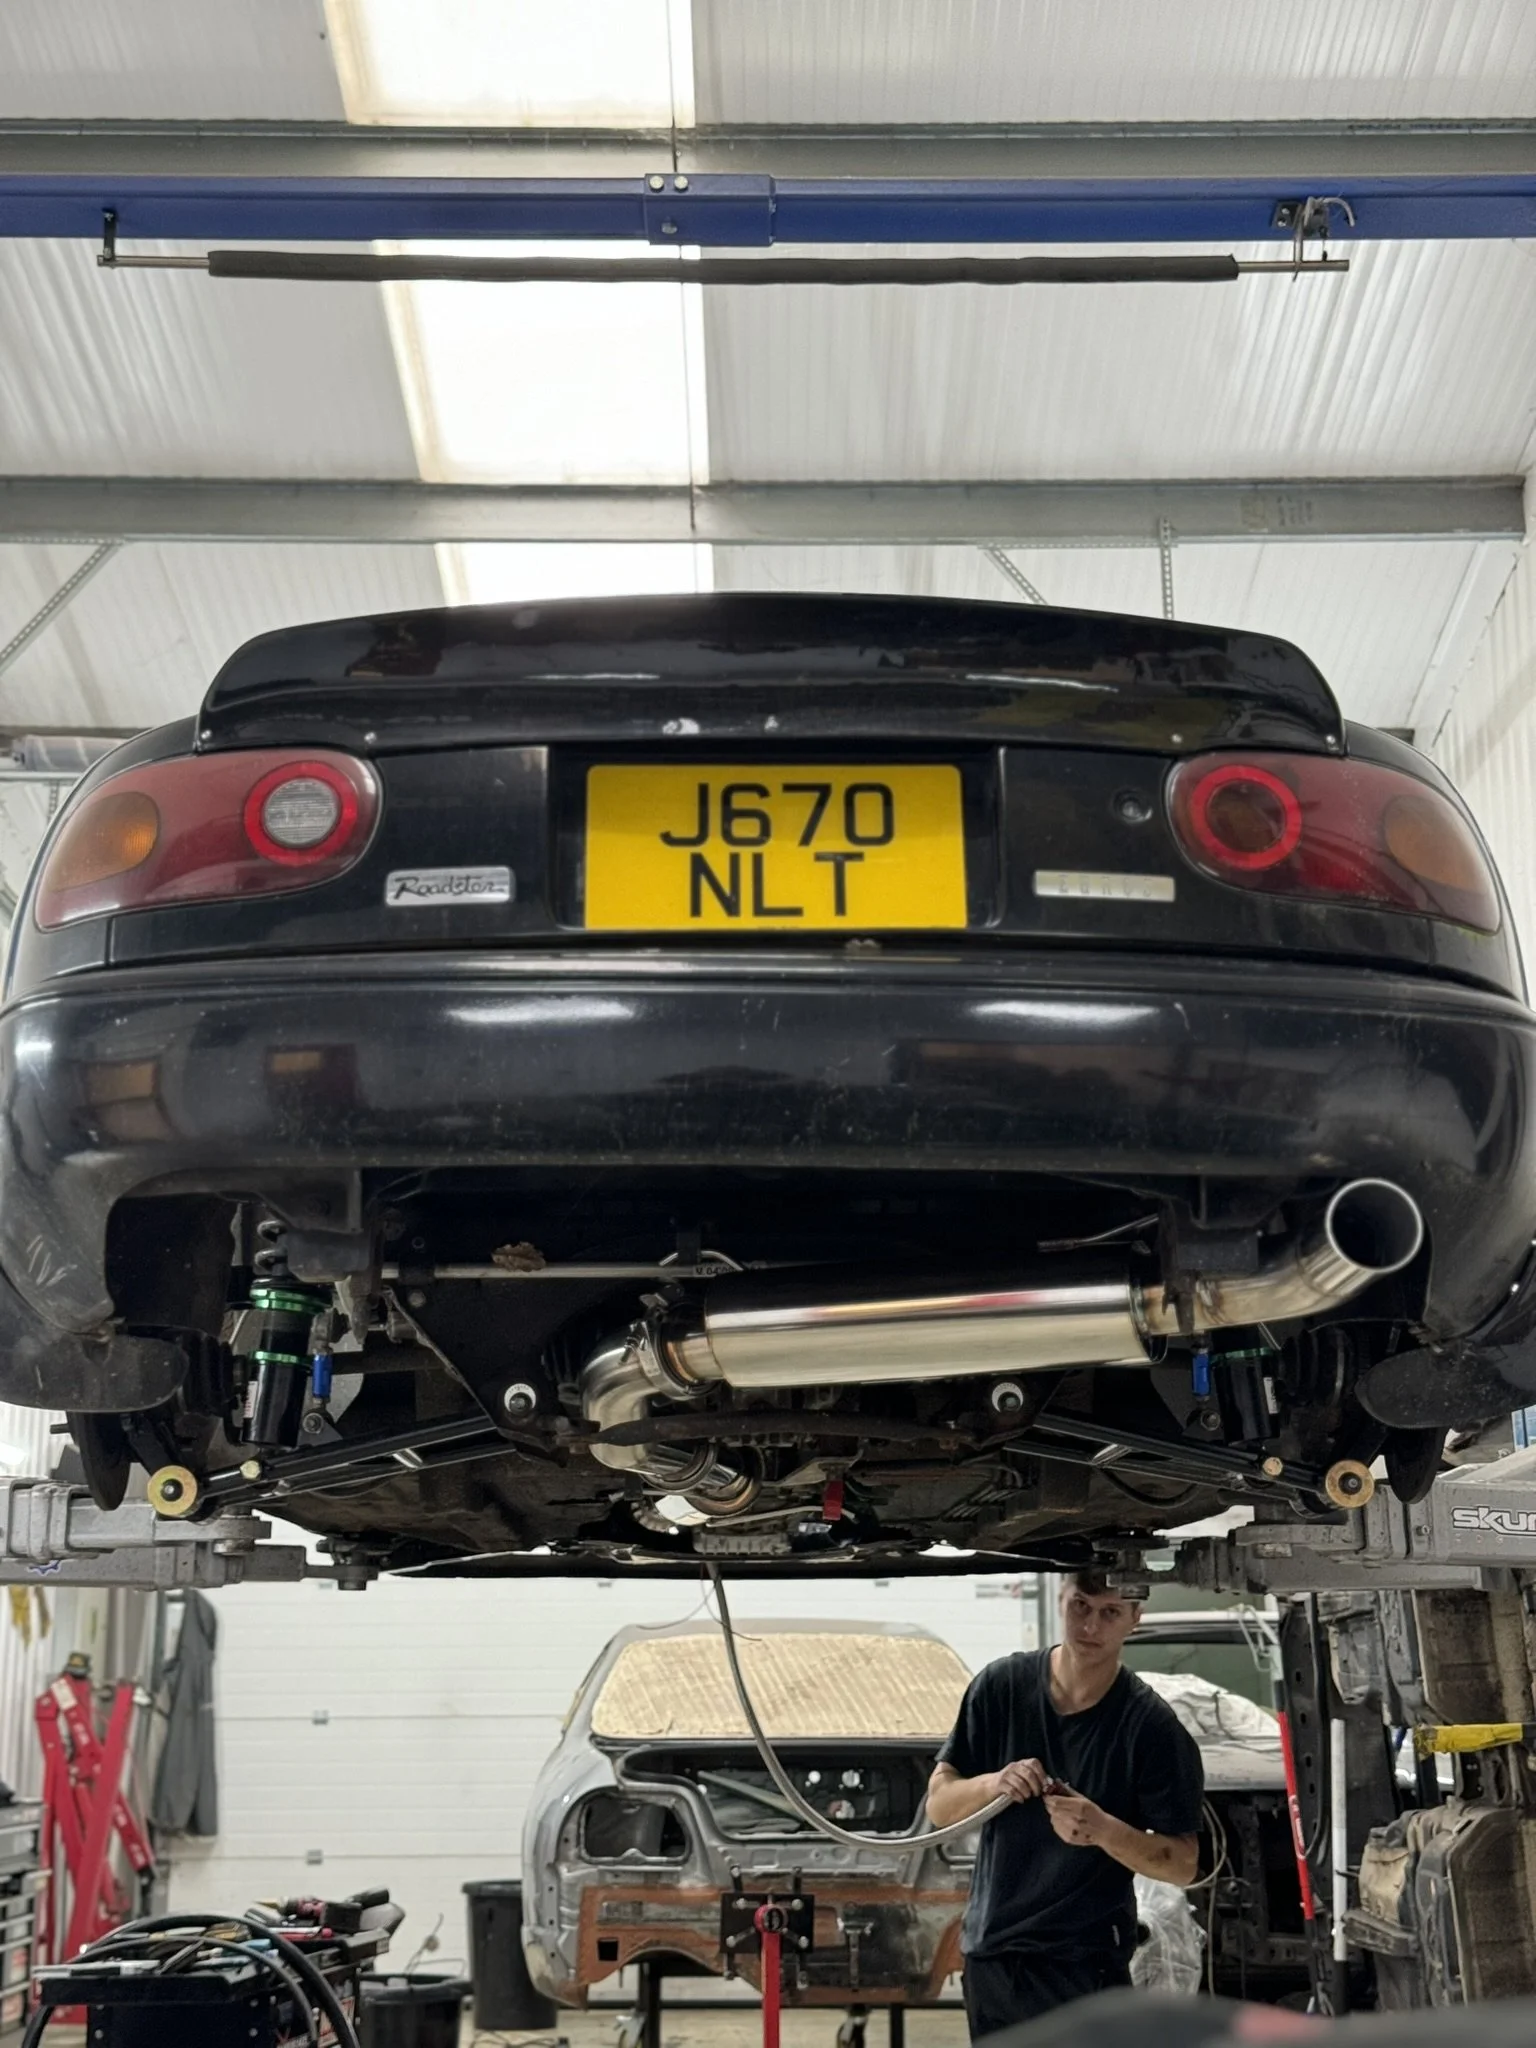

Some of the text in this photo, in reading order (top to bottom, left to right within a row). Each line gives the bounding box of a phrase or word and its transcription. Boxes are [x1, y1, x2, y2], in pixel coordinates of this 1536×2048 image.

[659, 783, 894, 847] J670
[393, 875, 506, 900] Roadster
[689, 852, 865, 918] NLT
